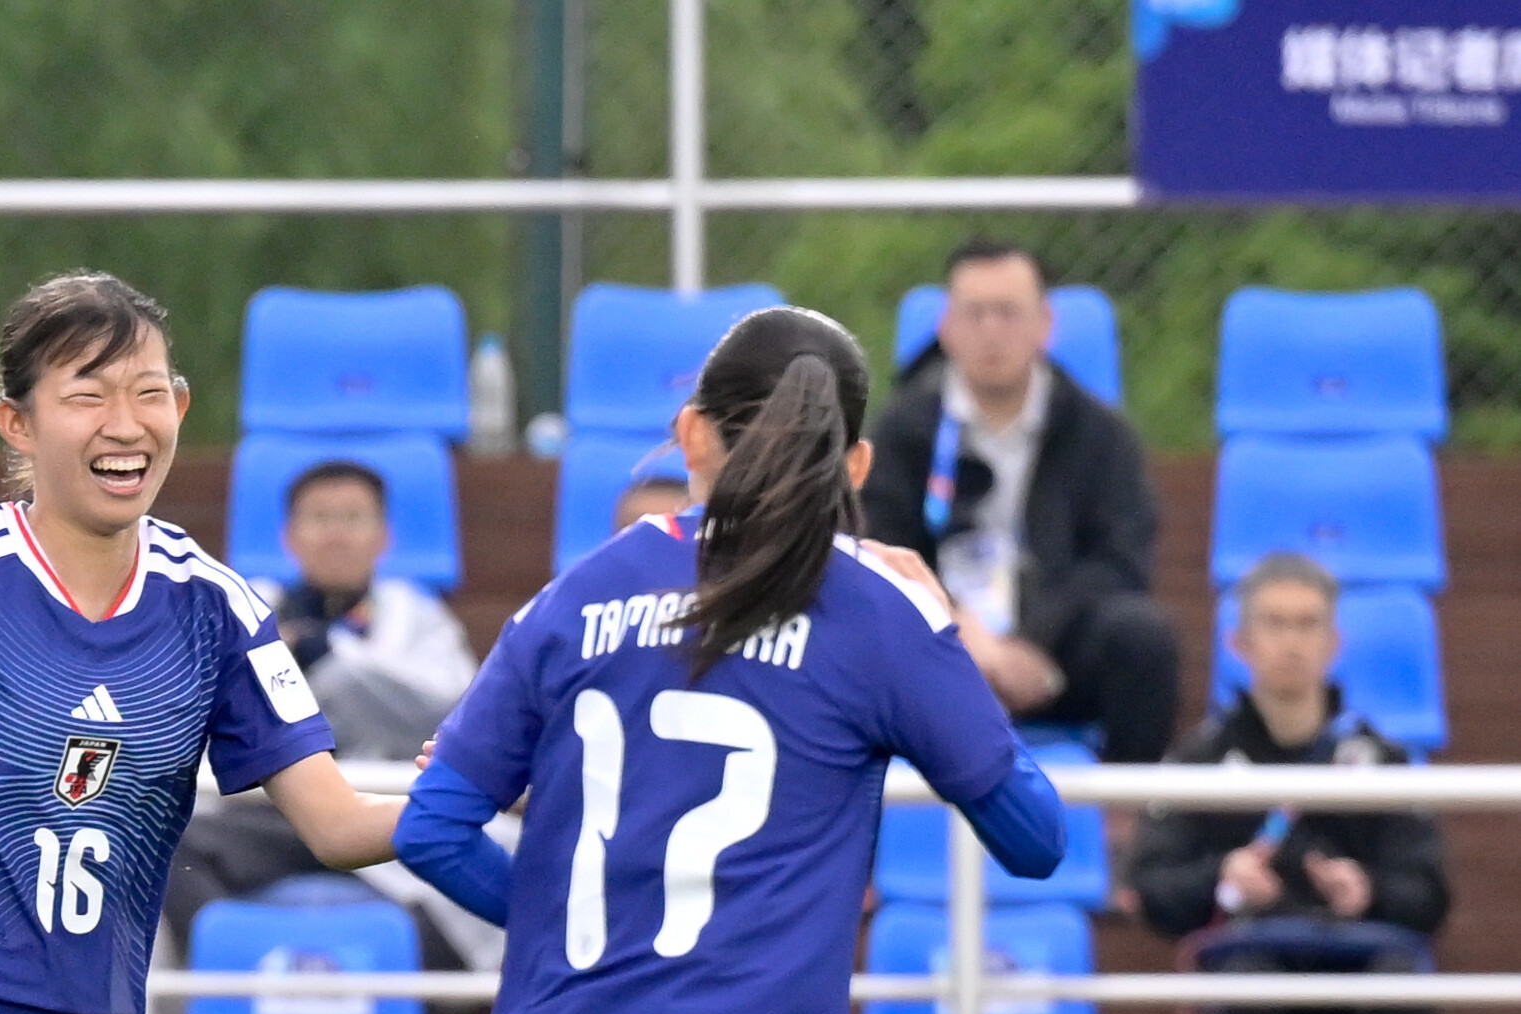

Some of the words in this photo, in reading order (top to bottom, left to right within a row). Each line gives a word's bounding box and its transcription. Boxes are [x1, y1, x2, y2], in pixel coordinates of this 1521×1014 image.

[78, 740, 108, 748] JAPAN
[33, 827, 111, 935] 16
[565, 688, 778, 970] 17
